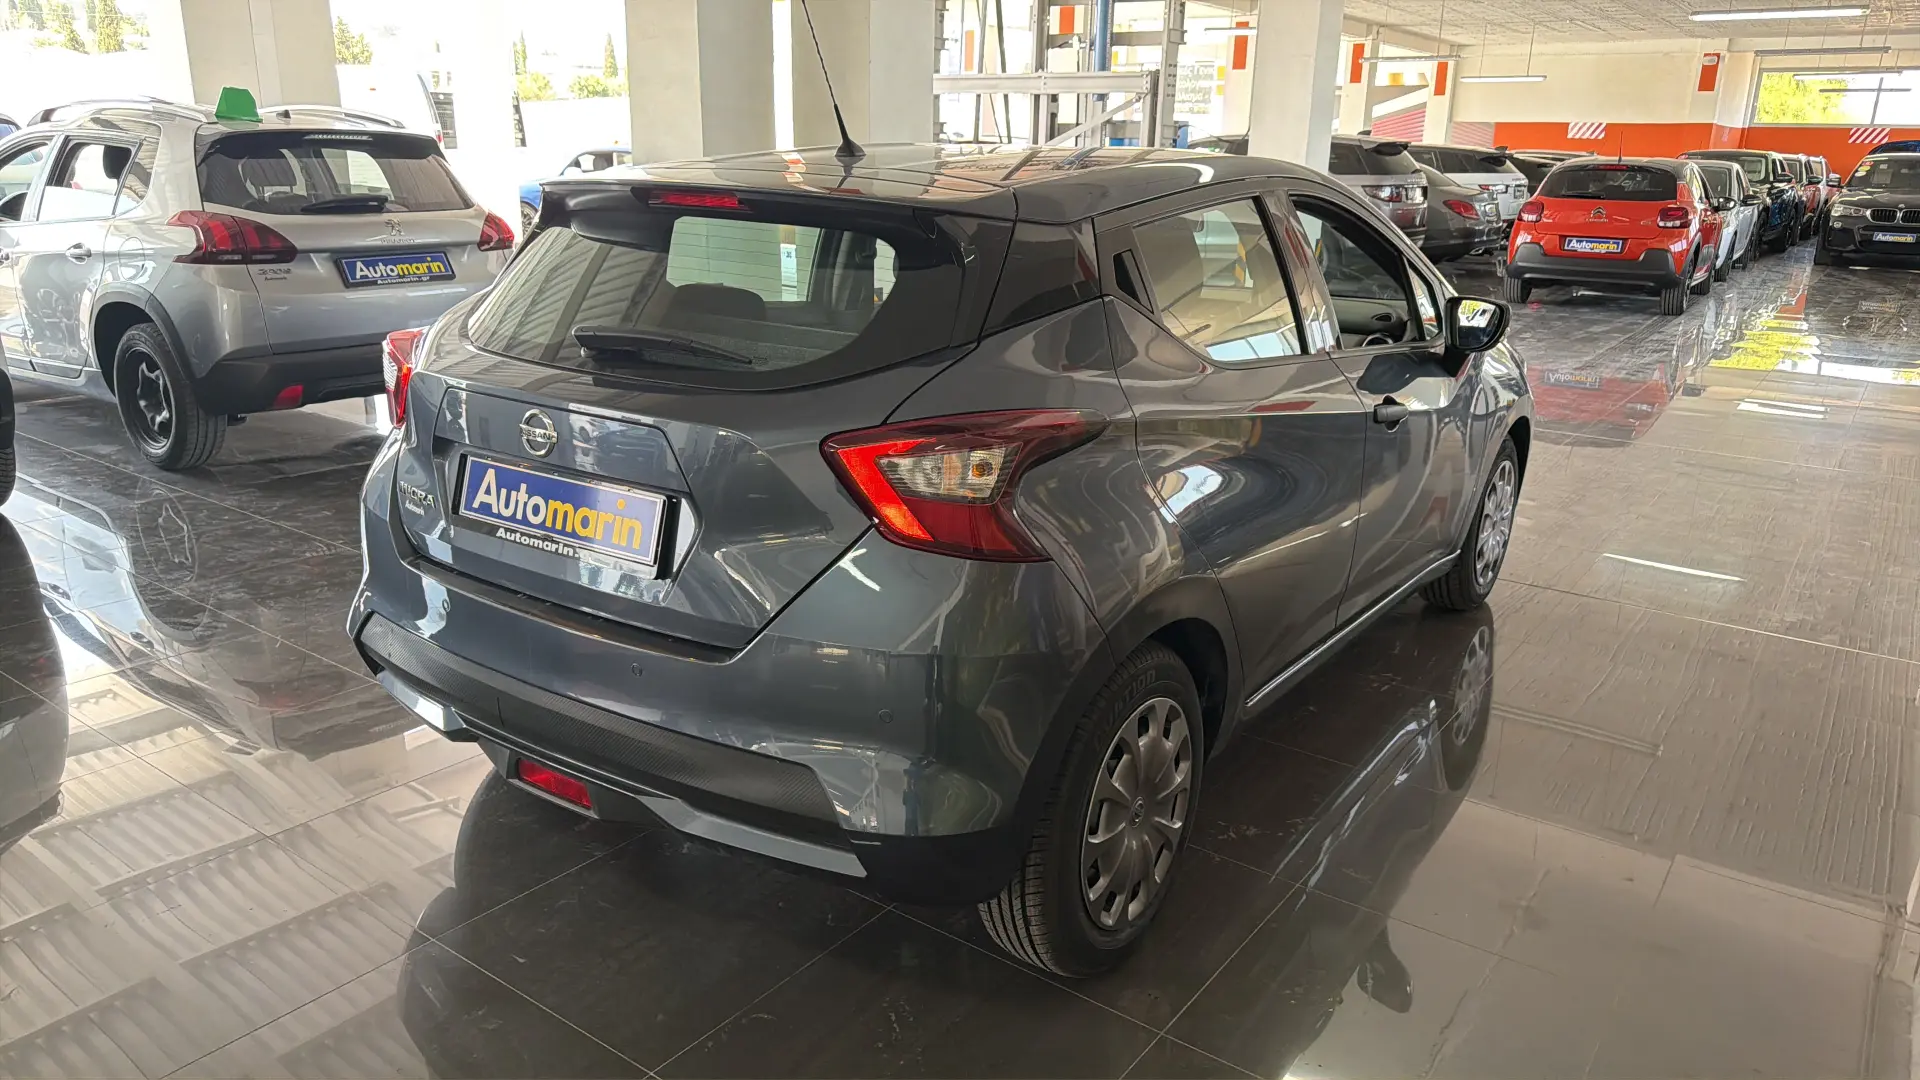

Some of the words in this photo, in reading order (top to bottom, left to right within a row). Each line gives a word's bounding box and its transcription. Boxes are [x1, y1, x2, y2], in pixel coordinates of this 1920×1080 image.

[1569, 239, 1617, 250] Automarin
[1875, 233, 1914, 242] Automarin
[355, 256, 446, 279] Automarin
[377, 276, 430, 284] Automarin.gr
[472, 468, 642, 549] Automarin
[496, 527, 590, 562] Automarin.
